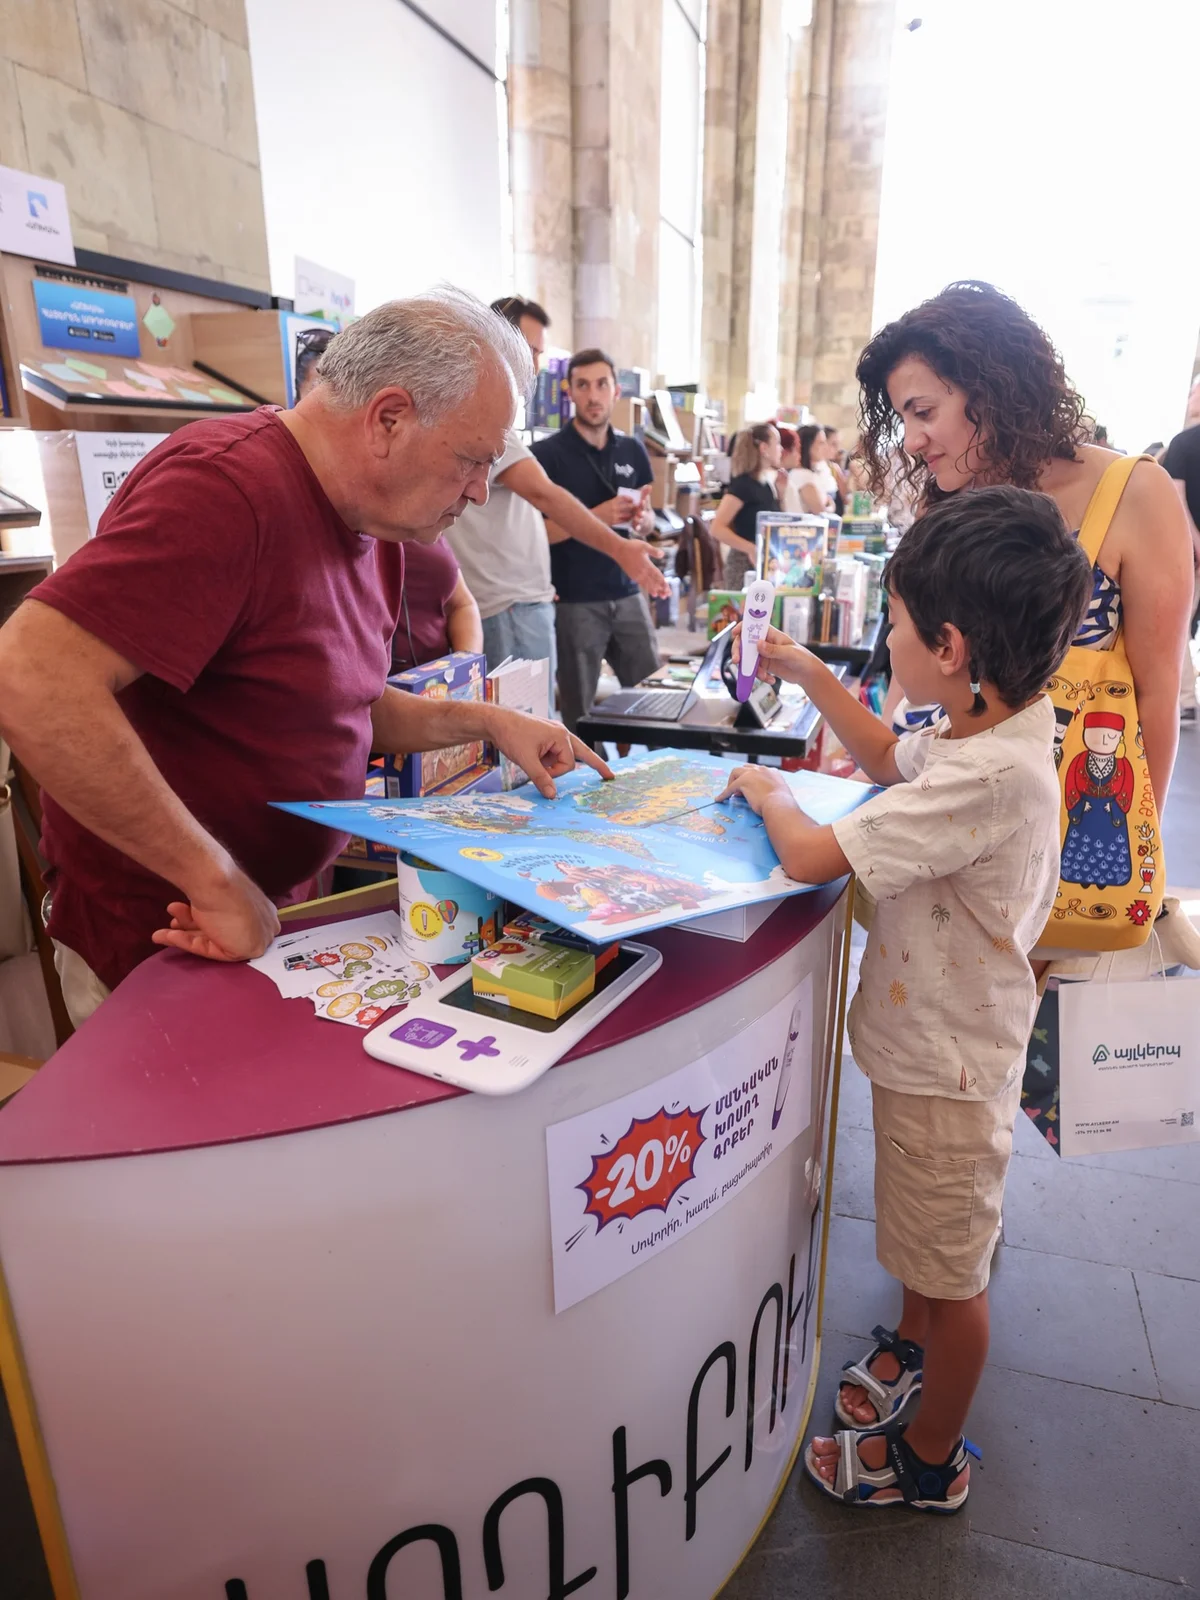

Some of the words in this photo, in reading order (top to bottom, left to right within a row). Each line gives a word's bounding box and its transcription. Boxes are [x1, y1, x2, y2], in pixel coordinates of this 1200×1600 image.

[1114, 1043, 1181, 1061] այլկերպ
[715, 1056, 779, 1115] ՄԱՆԿԱԿԱՆ
[713, 1118, 754, 1160] ԳՐՔԵՐ
[714, 1093, 760, 1140] ԽՈՍՈՂ
[595, 1130, 691, 1208] -20%
